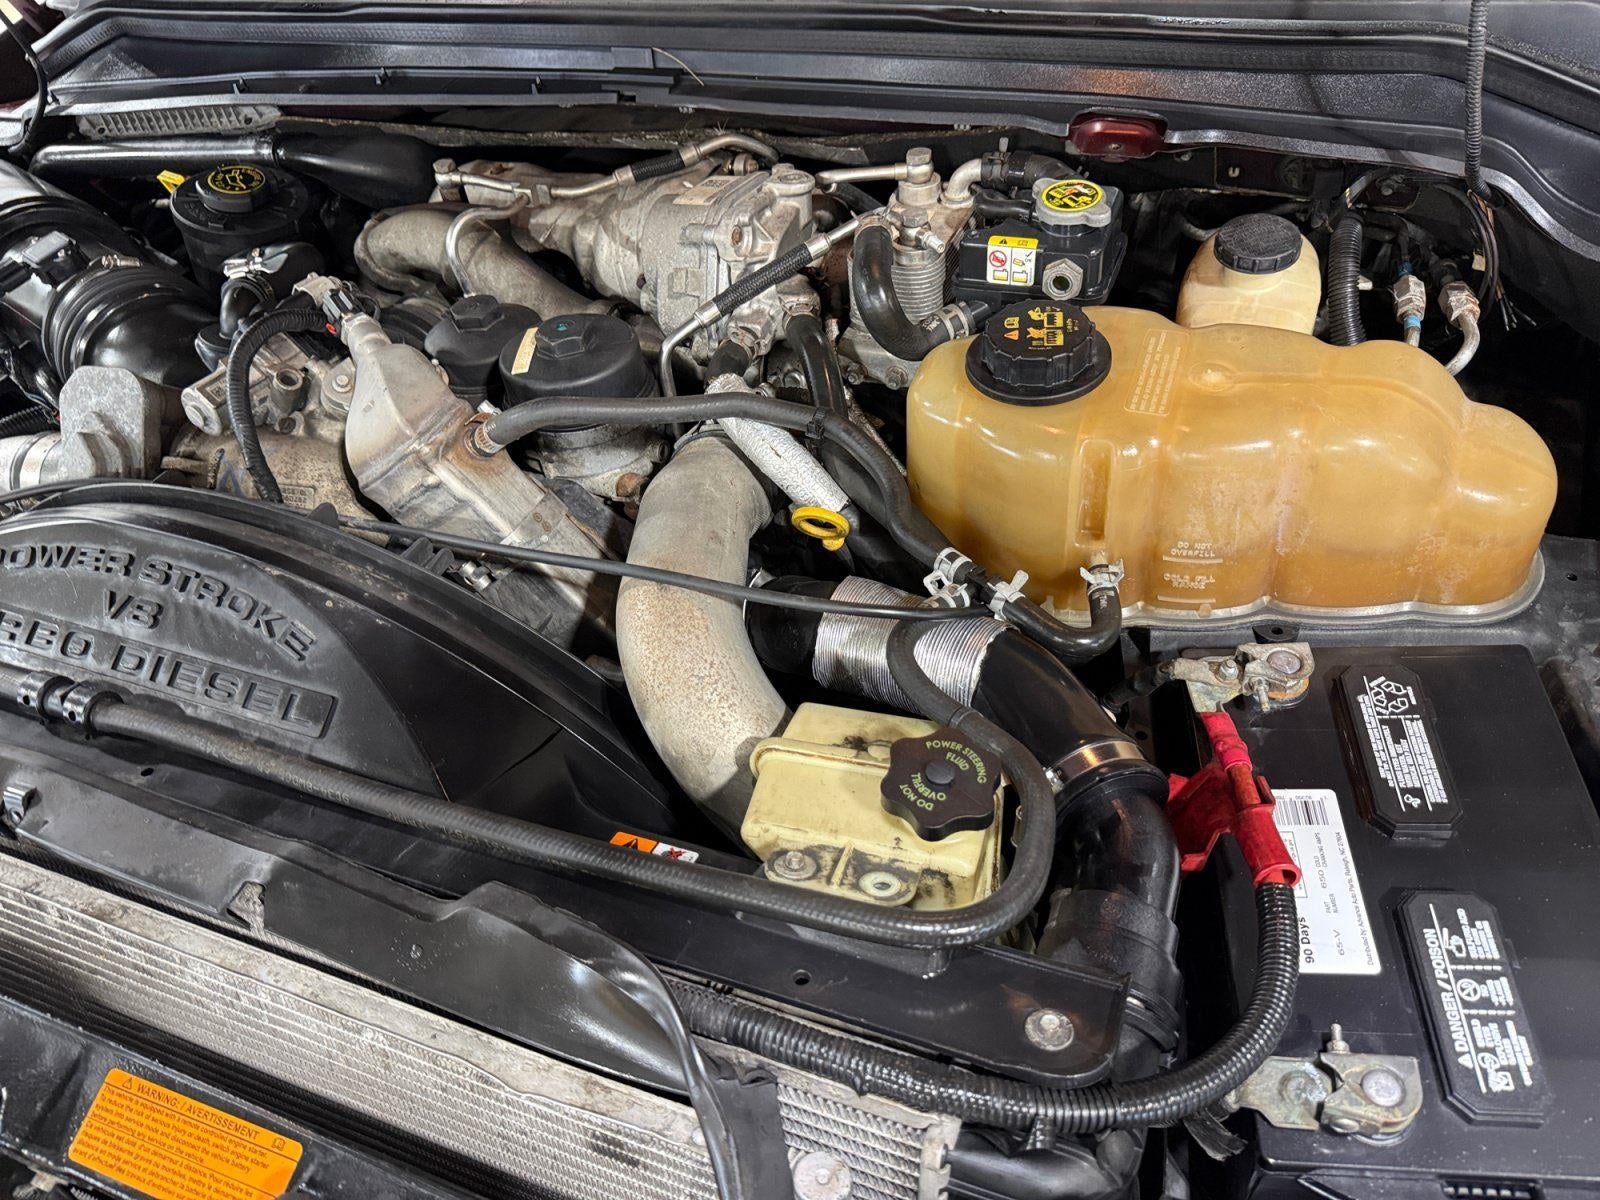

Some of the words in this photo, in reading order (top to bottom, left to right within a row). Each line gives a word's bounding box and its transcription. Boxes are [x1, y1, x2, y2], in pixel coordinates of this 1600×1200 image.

[0, 545, 136, 577] OWER
[139, 556, 319, 662] STROKE
[103, 589, 164, 630] V8
[112, 644, 312, 728] DIESEL
[926, 740, 963, 752] POWER
[962, 747, 987, 783] STEERING
[946, 752, 969, 771] FLUID
[900, 784, 917, 801] NOT
[916, 799, 934, 811] DO
[1340, 847, 1345, 855] NC
[1318, 869, 1327, 888] 650
[1330, 893, 1338, 913] NUMBER
[1355, 905, 1363, 926] Advance
[1298, 917, 1311, 944] Days
[1303, 948, 1314, 963] 90
[135, 1083, 182, 1109] WARNING:
[185, 1104, 259, 1141] AVERTISSEMENT
